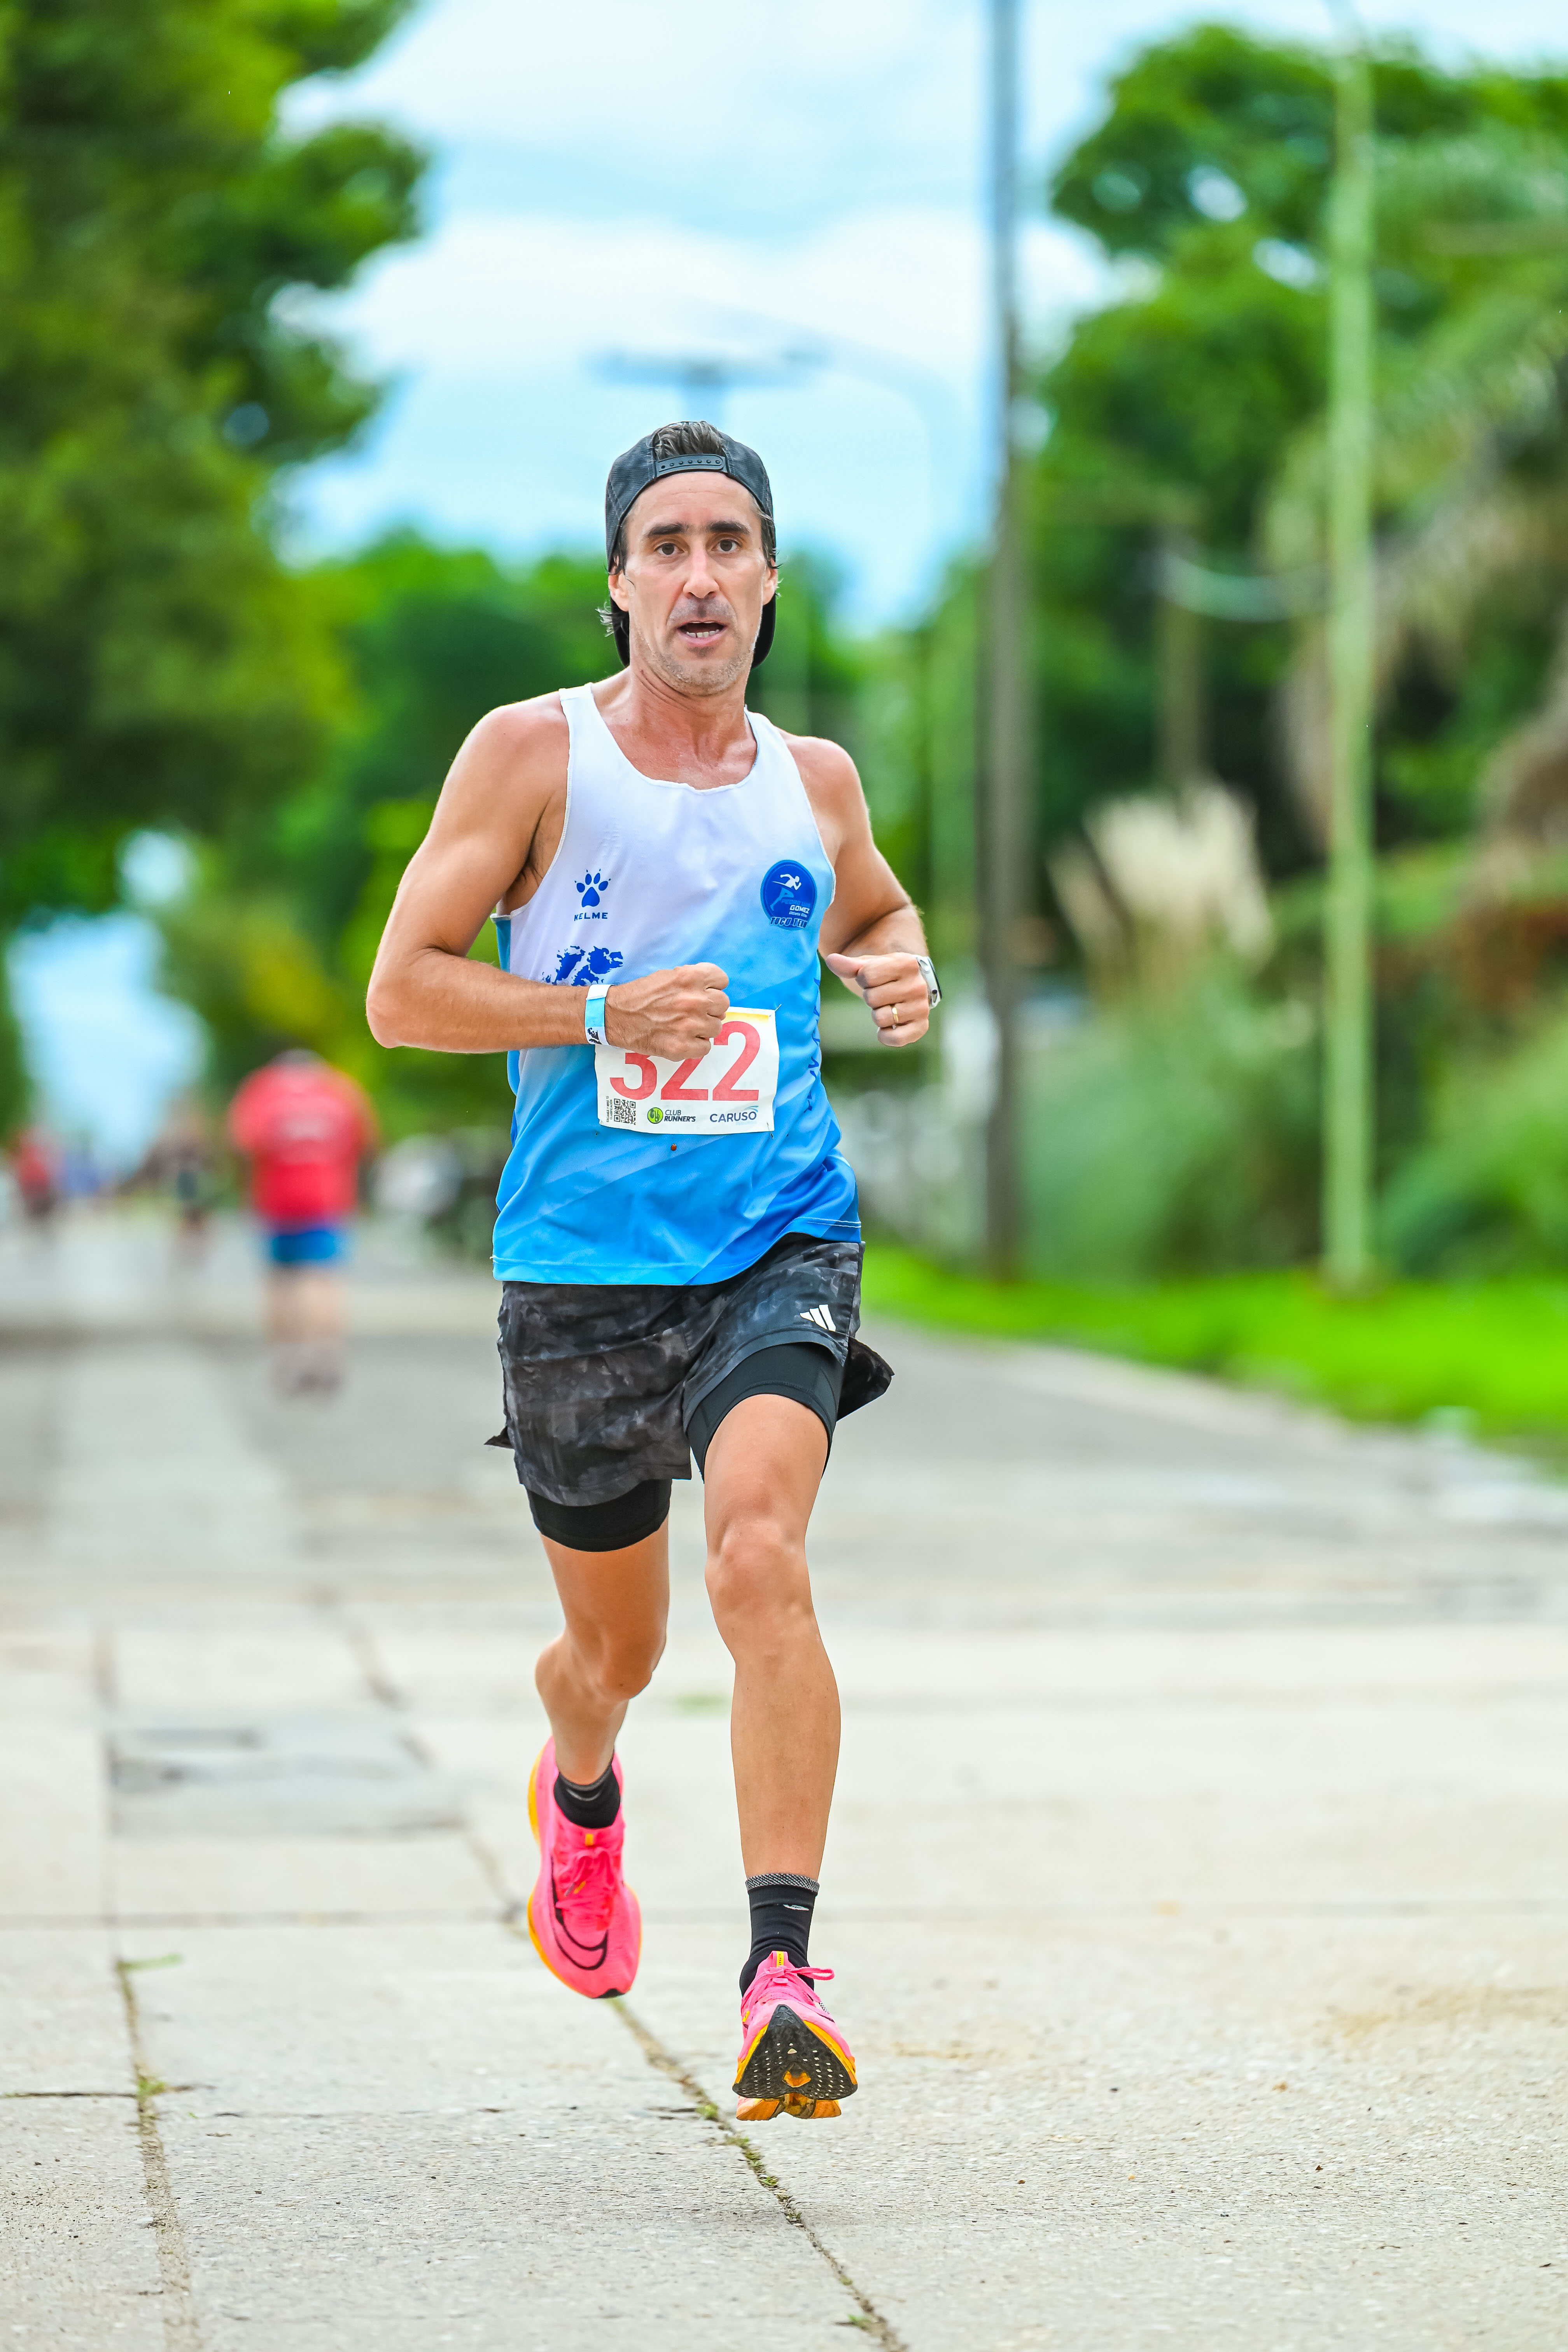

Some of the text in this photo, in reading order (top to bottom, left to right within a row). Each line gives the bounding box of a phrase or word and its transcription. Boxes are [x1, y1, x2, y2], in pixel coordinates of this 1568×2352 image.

[790, 905, 810, 914] GOMEZ
[574, 912, 608, 921] KELME
[770, 916, 792, 926] TUCU
[709, 1111, 757, 1122] CARUSO
